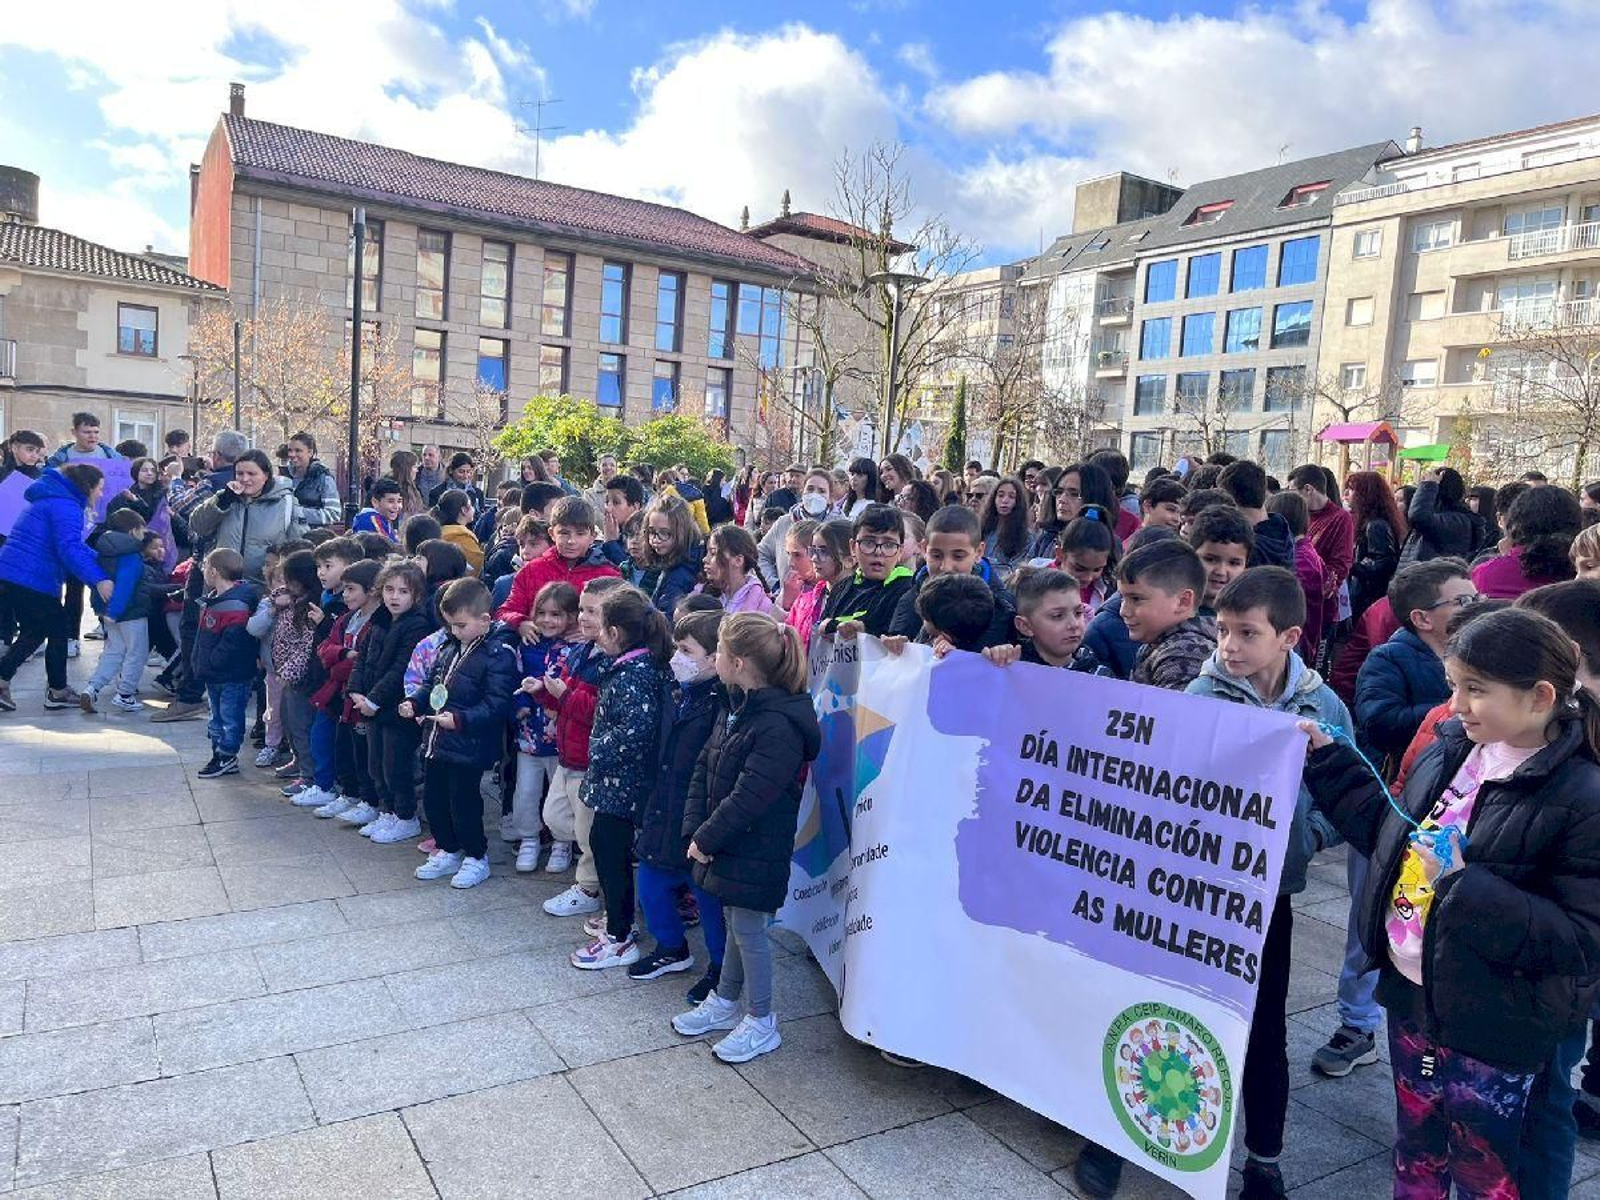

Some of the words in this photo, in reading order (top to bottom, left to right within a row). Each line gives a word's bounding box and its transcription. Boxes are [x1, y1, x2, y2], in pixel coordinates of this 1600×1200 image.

[1105, 709, 1155, 746] 25N
[1019, 729, 1059, 770] DÍA
[1066, 745, 1277, 830] INTERNACIONAL
[1014, 821, 1136, 889] VIOLENCIA
[1147, 867, 1263, 934] CONTRA
[1016, 778, 1050, 811] DA
[1059, 794, 1222, 865] ELIMINACIÓN
[1232, 841, 1268, 882] DA
[1072, 889, 1104, 924] AS
[1112, 904, 1258, 985] MULLERES
[1167, 1007, 1213, 1045] AMARO
